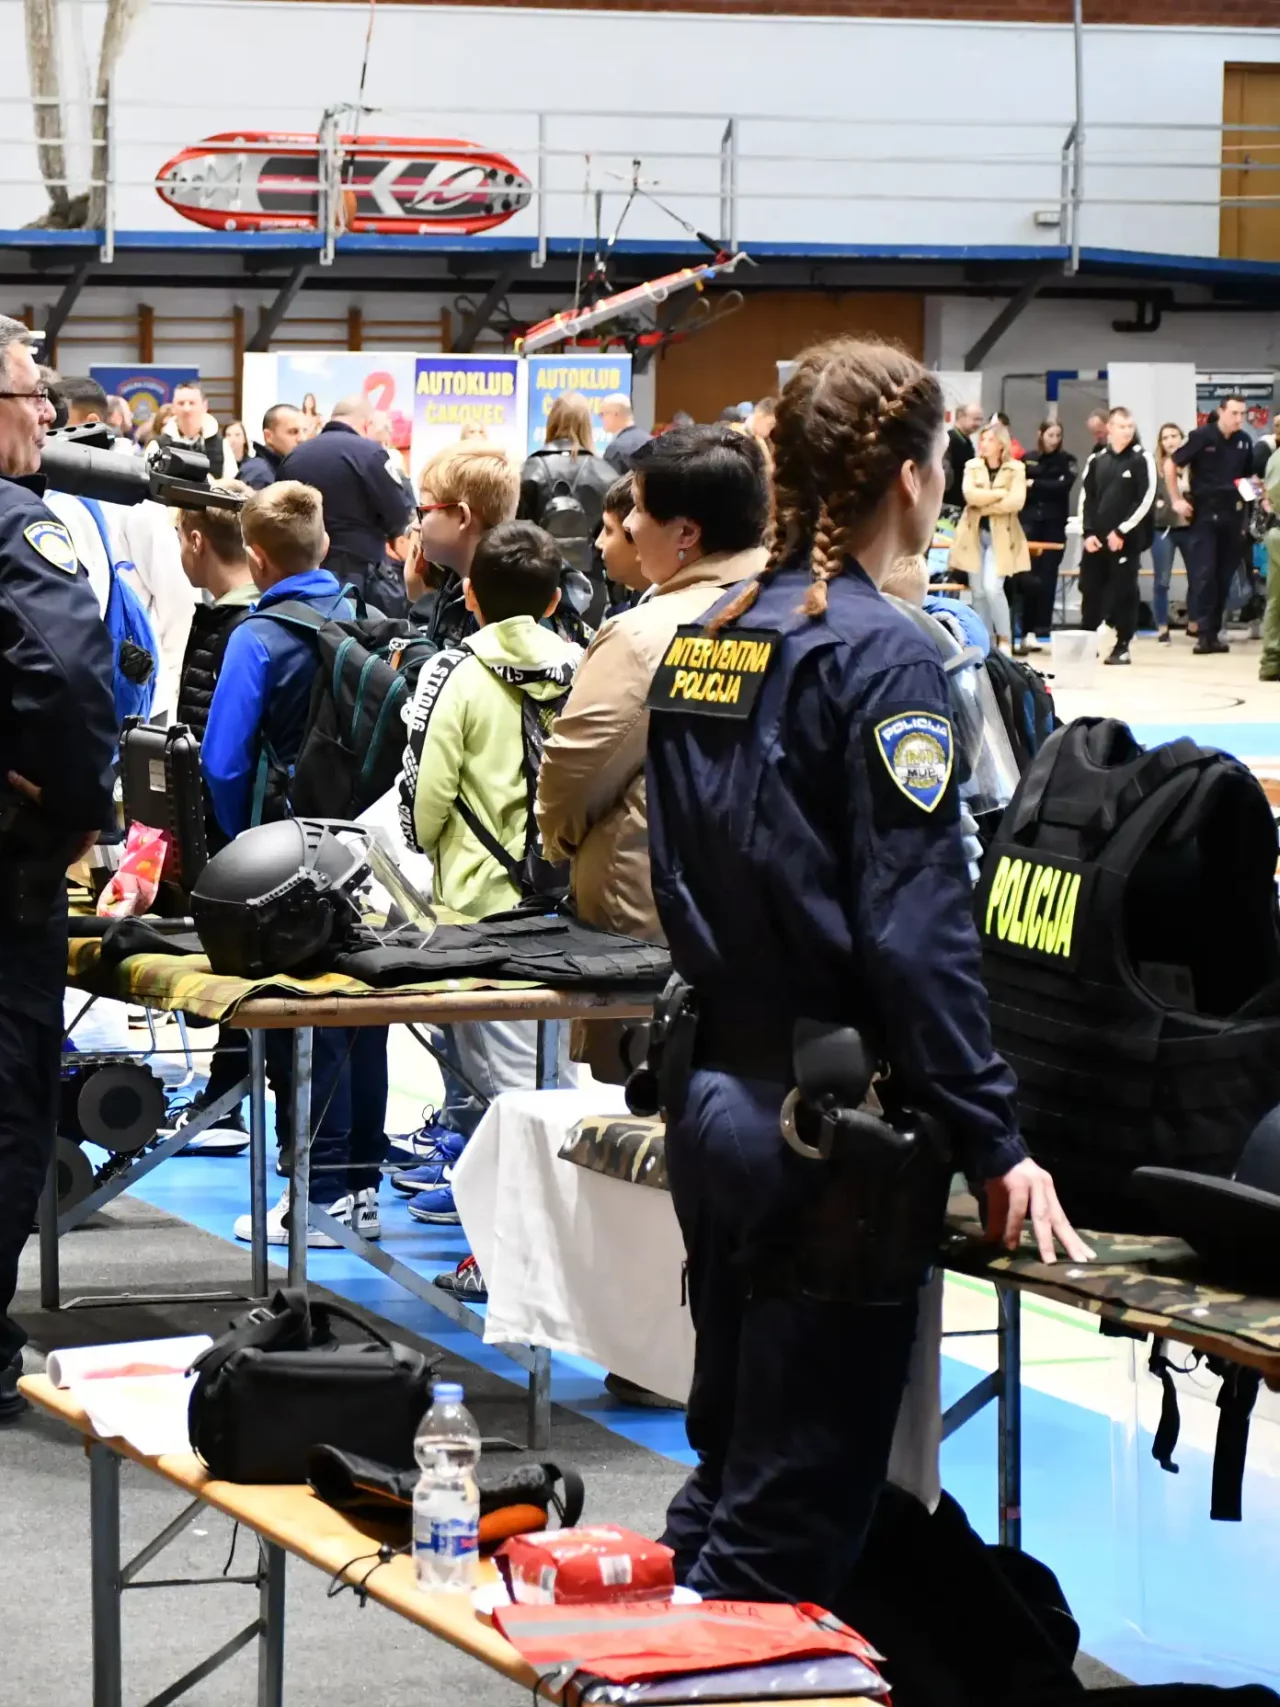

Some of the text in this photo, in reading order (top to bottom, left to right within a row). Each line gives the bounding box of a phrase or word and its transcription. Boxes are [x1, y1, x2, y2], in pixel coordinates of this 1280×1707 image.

[416, 371, 514, 396] AUTOKLUB
[536, 368, 621, 389] AUTOKLUB
[664, 637, 772, 672] INTERVENTNA
[669, 669, 742, 704] POLICIJA
[881, 717, 948, 740] POLICIJA
[985, 855, 1081, 957] POLICIJA
